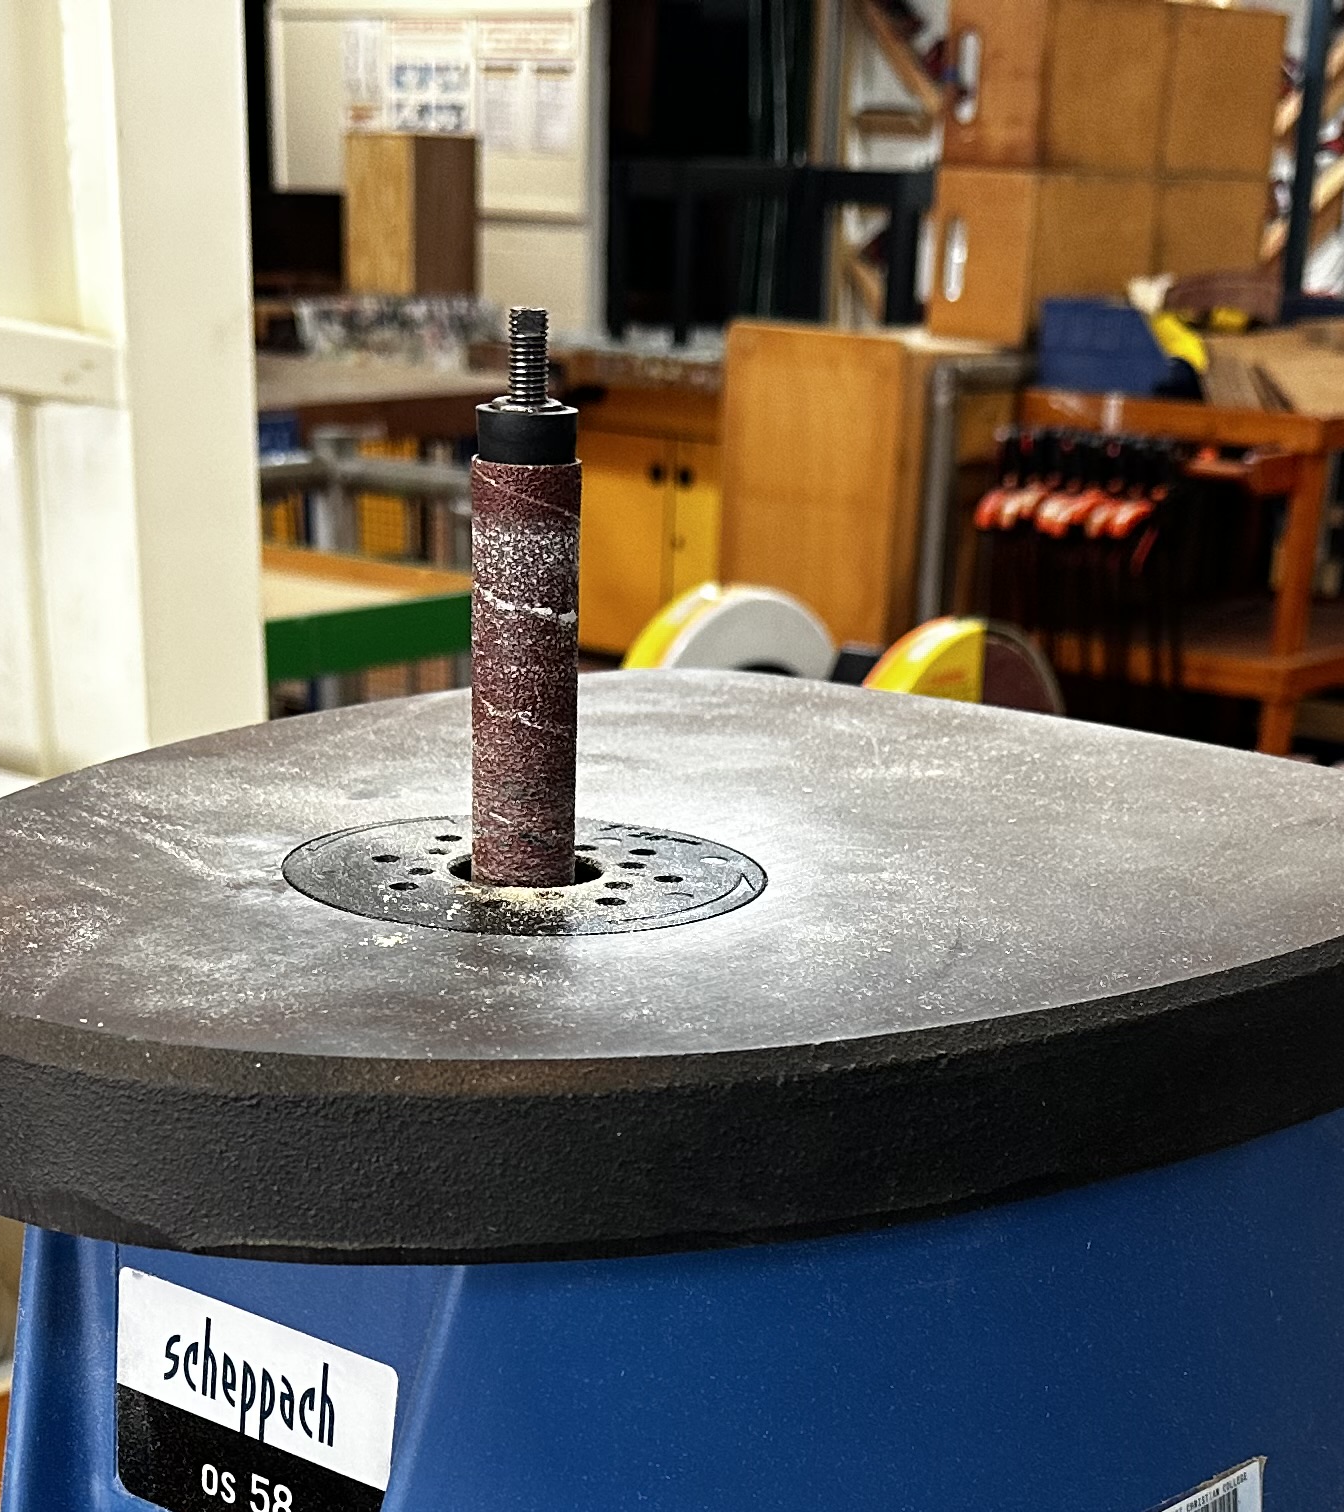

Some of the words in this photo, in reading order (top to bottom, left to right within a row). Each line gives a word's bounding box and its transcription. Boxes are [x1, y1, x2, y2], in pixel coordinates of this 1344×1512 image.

[164, 1316, 335, 1448] scheppach
[1186, 1487, 1220, 1512] CHRISTIAN
[1222, 1471, 1248, 1493] COLLEGE
